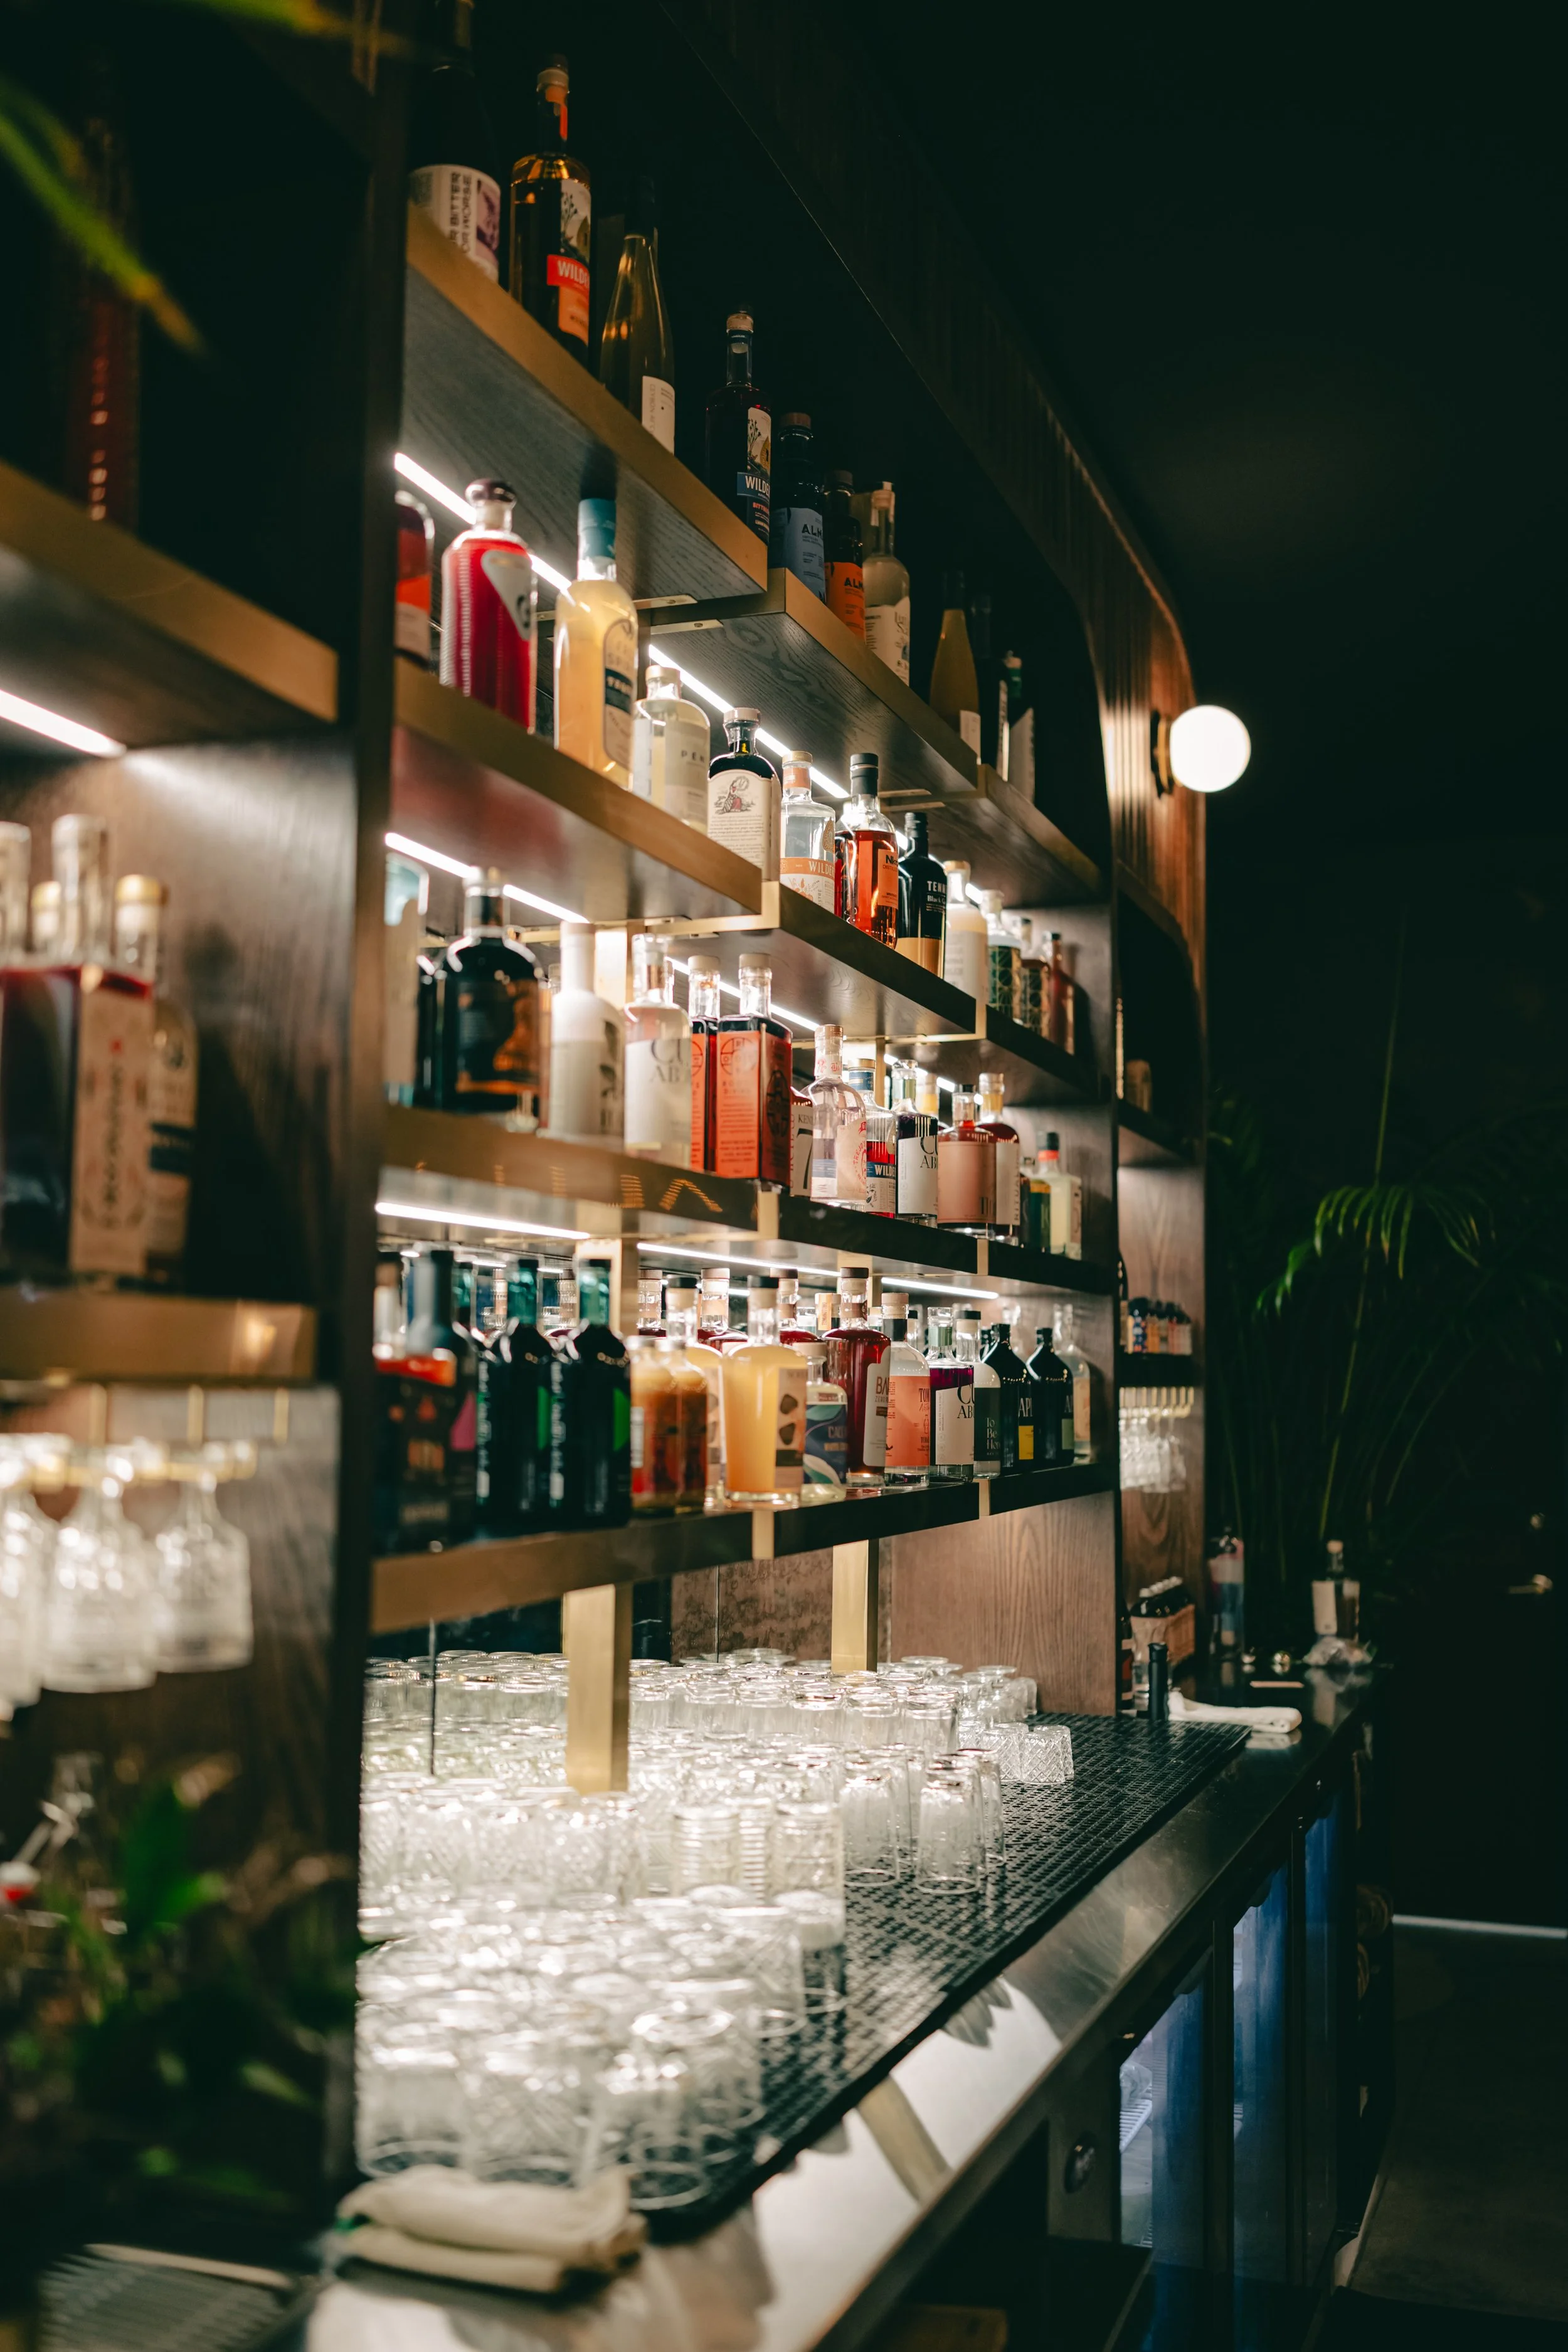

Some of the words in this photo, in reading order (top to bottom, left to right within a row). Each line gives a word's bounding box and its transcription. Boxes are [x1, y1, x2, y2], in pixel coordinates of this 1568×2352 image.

[450, 172, 461, 226] BITTER
[462, 175, 472, 228] WORSE
[985, 1417, 995, 1428] To
[987, 1428, 997, 1439] Be
